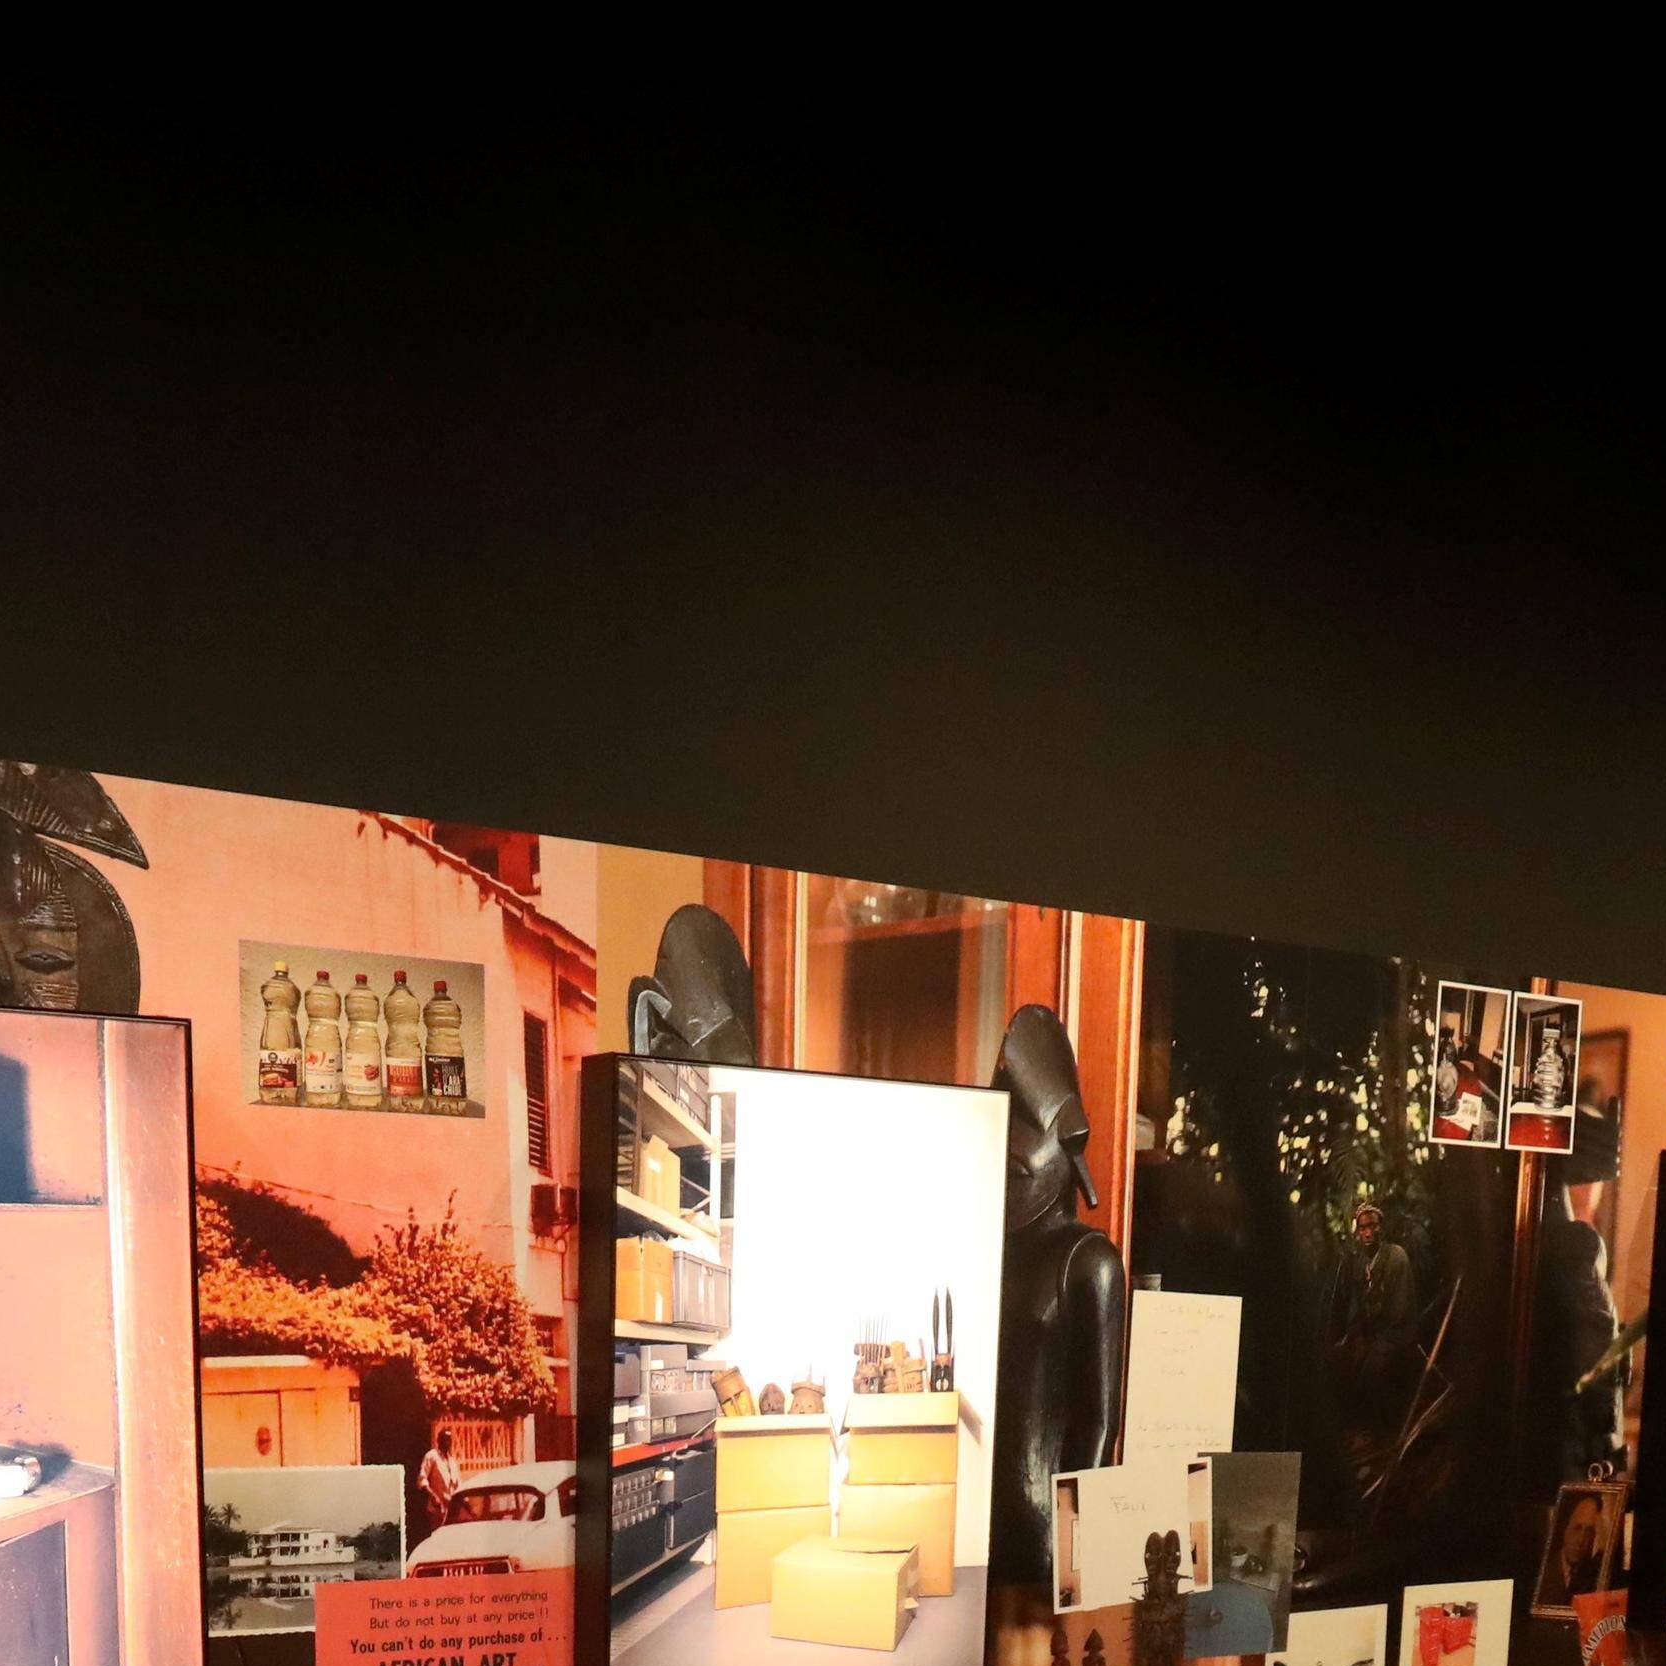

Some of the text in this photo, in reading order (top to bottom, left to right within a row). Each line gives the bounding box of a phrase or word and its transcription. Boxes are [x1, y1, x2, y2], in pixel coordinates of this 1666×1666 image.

[369, 1597, 404, 1611] There
[408, 1597, 419, 1608] is
[435, 1593, 465, 1609] price
[469, 1592, 484, 1605] for
[491, 1590, 549, 1605] everything
[369, 1616, 389, 1630] But
[394, 1614, 410, 1628] do
[415, 1615, 435, 1627] not
[440, 1611, 461, 1626] buy
[466, 1612, 478, 1624] at
[483, 1611, 503, 1625] any
[507, 1608, 535, 1622] price
[350, 1638, 375, 1654] You
[382, 1635, 414, 1653] can't
[419, 1633, 436, 1650] do
[441, 1634, 464, 1651] any
[468, 1629, 526, 1648] purchase
